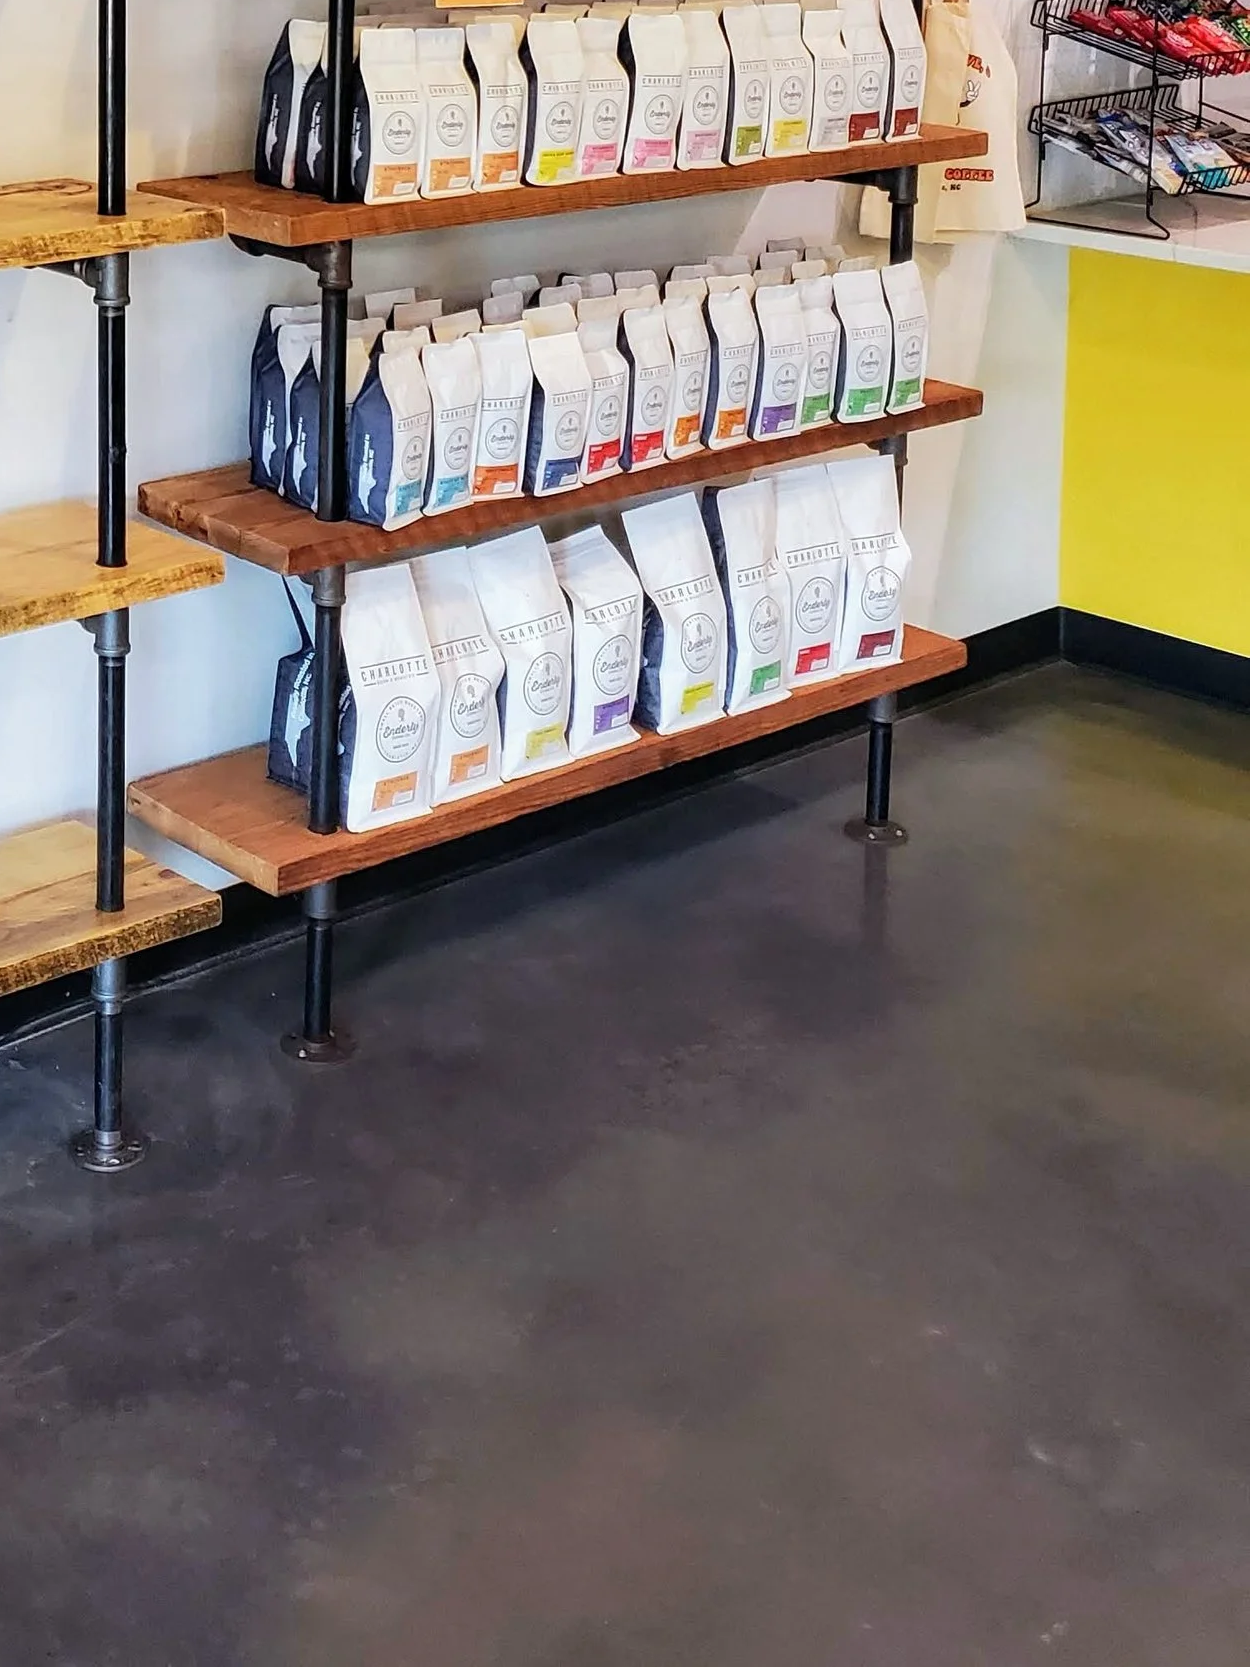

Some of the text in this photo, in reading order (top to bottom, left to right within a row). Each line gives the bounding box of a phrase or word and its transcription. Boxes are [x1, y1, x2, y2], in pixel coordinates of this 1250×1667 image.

[944, 168, 994, 182] COFFEE
[787, 544, 841, 566] CHARLOTTE
[500, 615, 566, 642] CHARLOTTE
[360, 658, 429, 682] CHARLOTTE
[383, 721, 419, 739] Enderly
